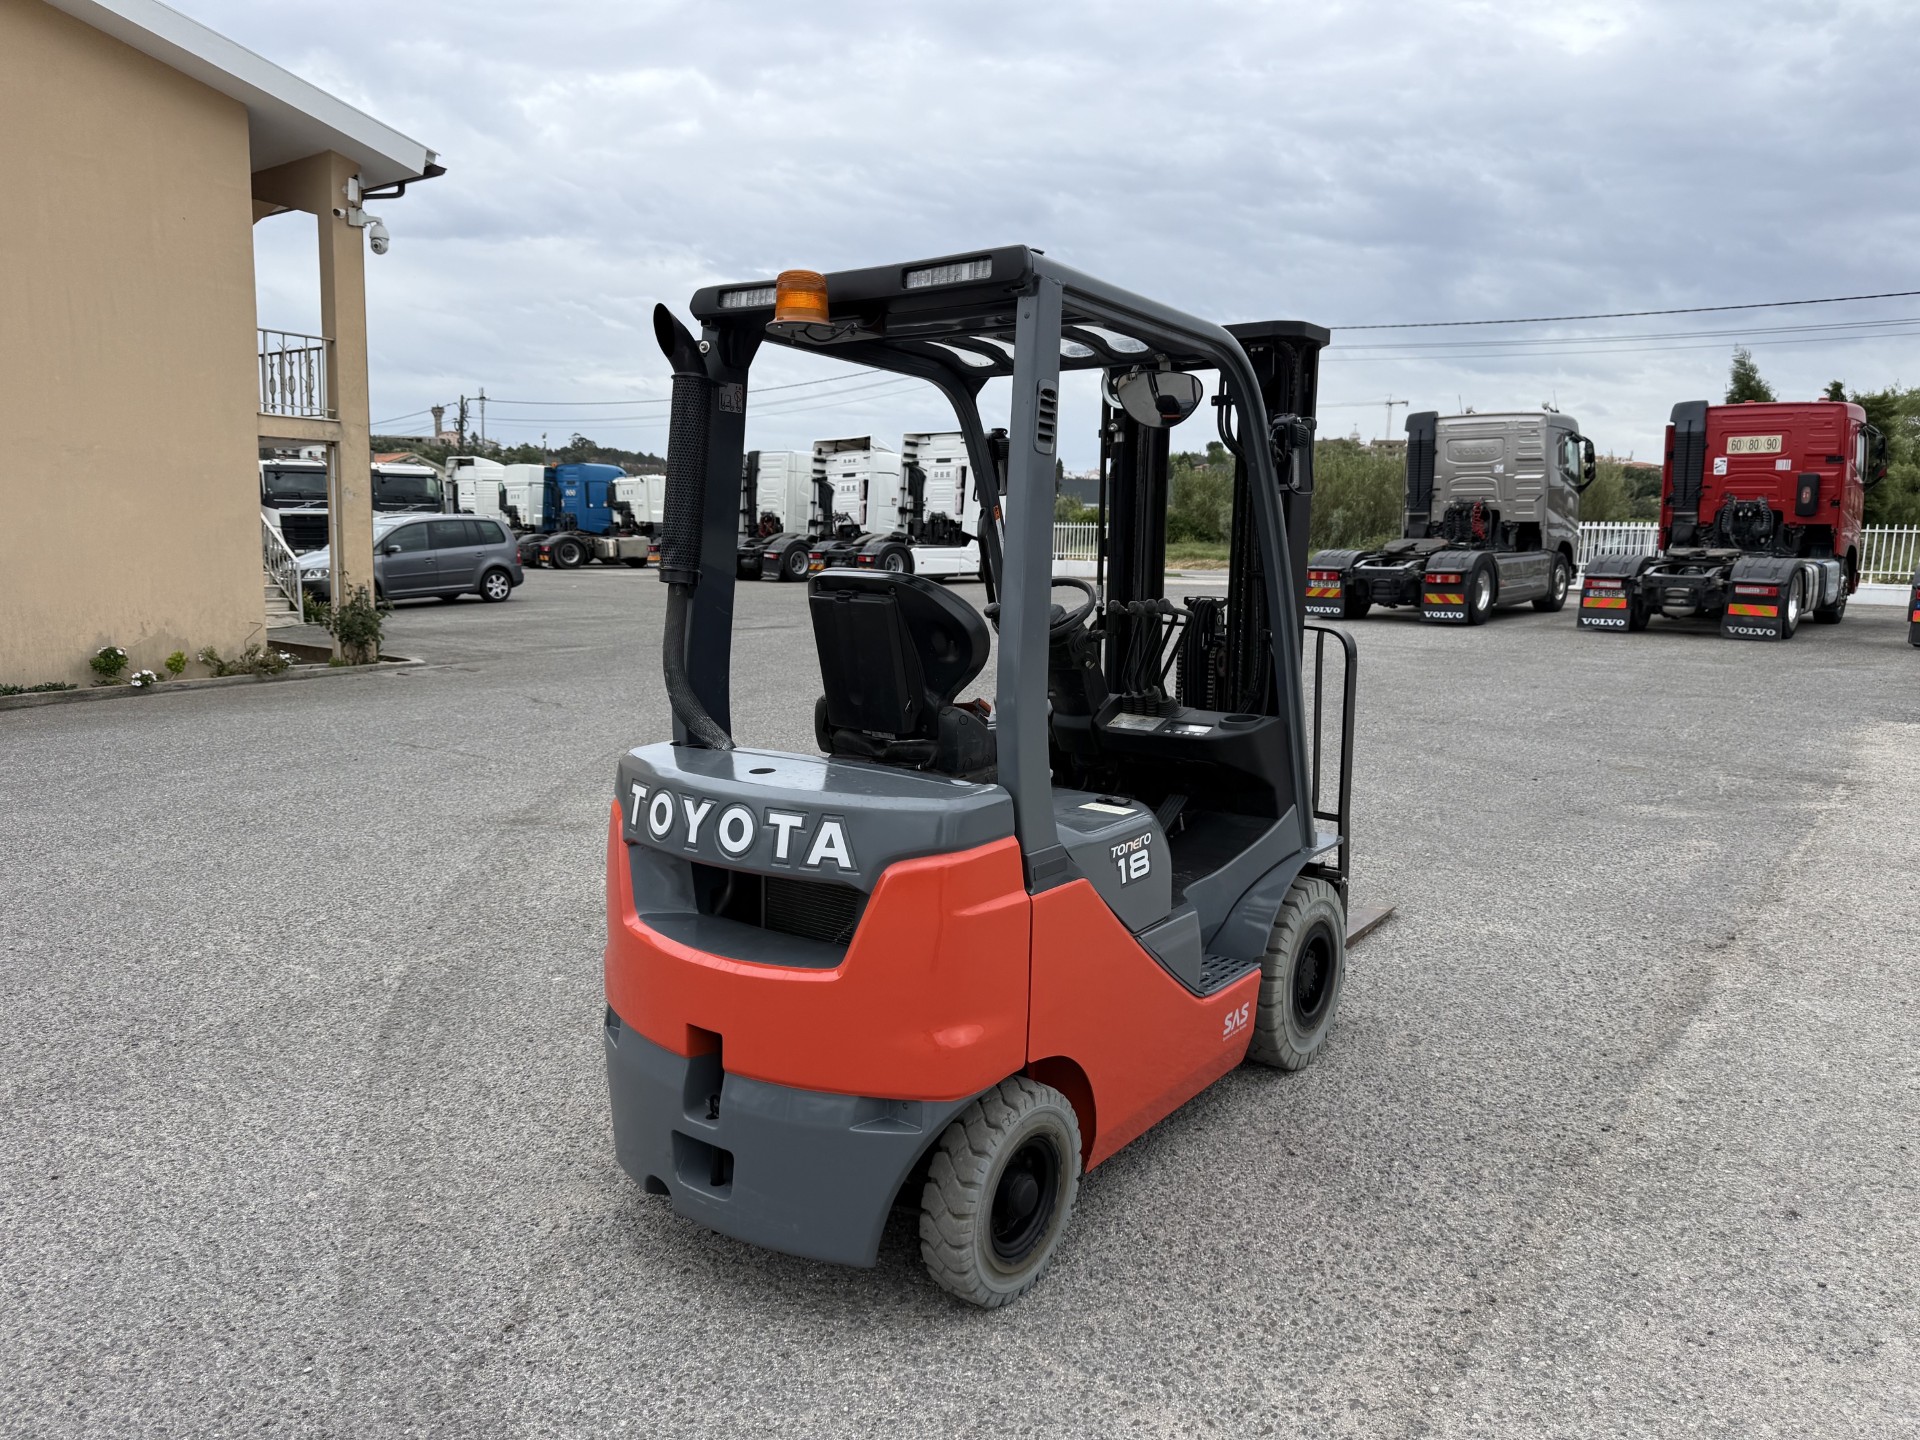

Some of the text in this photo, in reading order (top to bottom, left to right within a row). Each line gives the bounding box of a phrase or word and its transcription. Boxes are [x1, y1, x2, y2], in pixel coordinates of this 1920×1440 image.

[1731, 438, 1777, 451] 60 80 90
[1453, 446, 1497, 456] VOLVO
[1305, 606, 1341, 614] VOLVO
[1425, 611, 1464, 619] VOLVO
[1581, 617, 1626, 626] VOLVO
[1726, 625, 1777, 637] VOLVO
[631, 783, 852, 869] TOYOTA
[1117, 849, 1150, 885] 18
[1222, 1001, 1250, 1036] SAS
